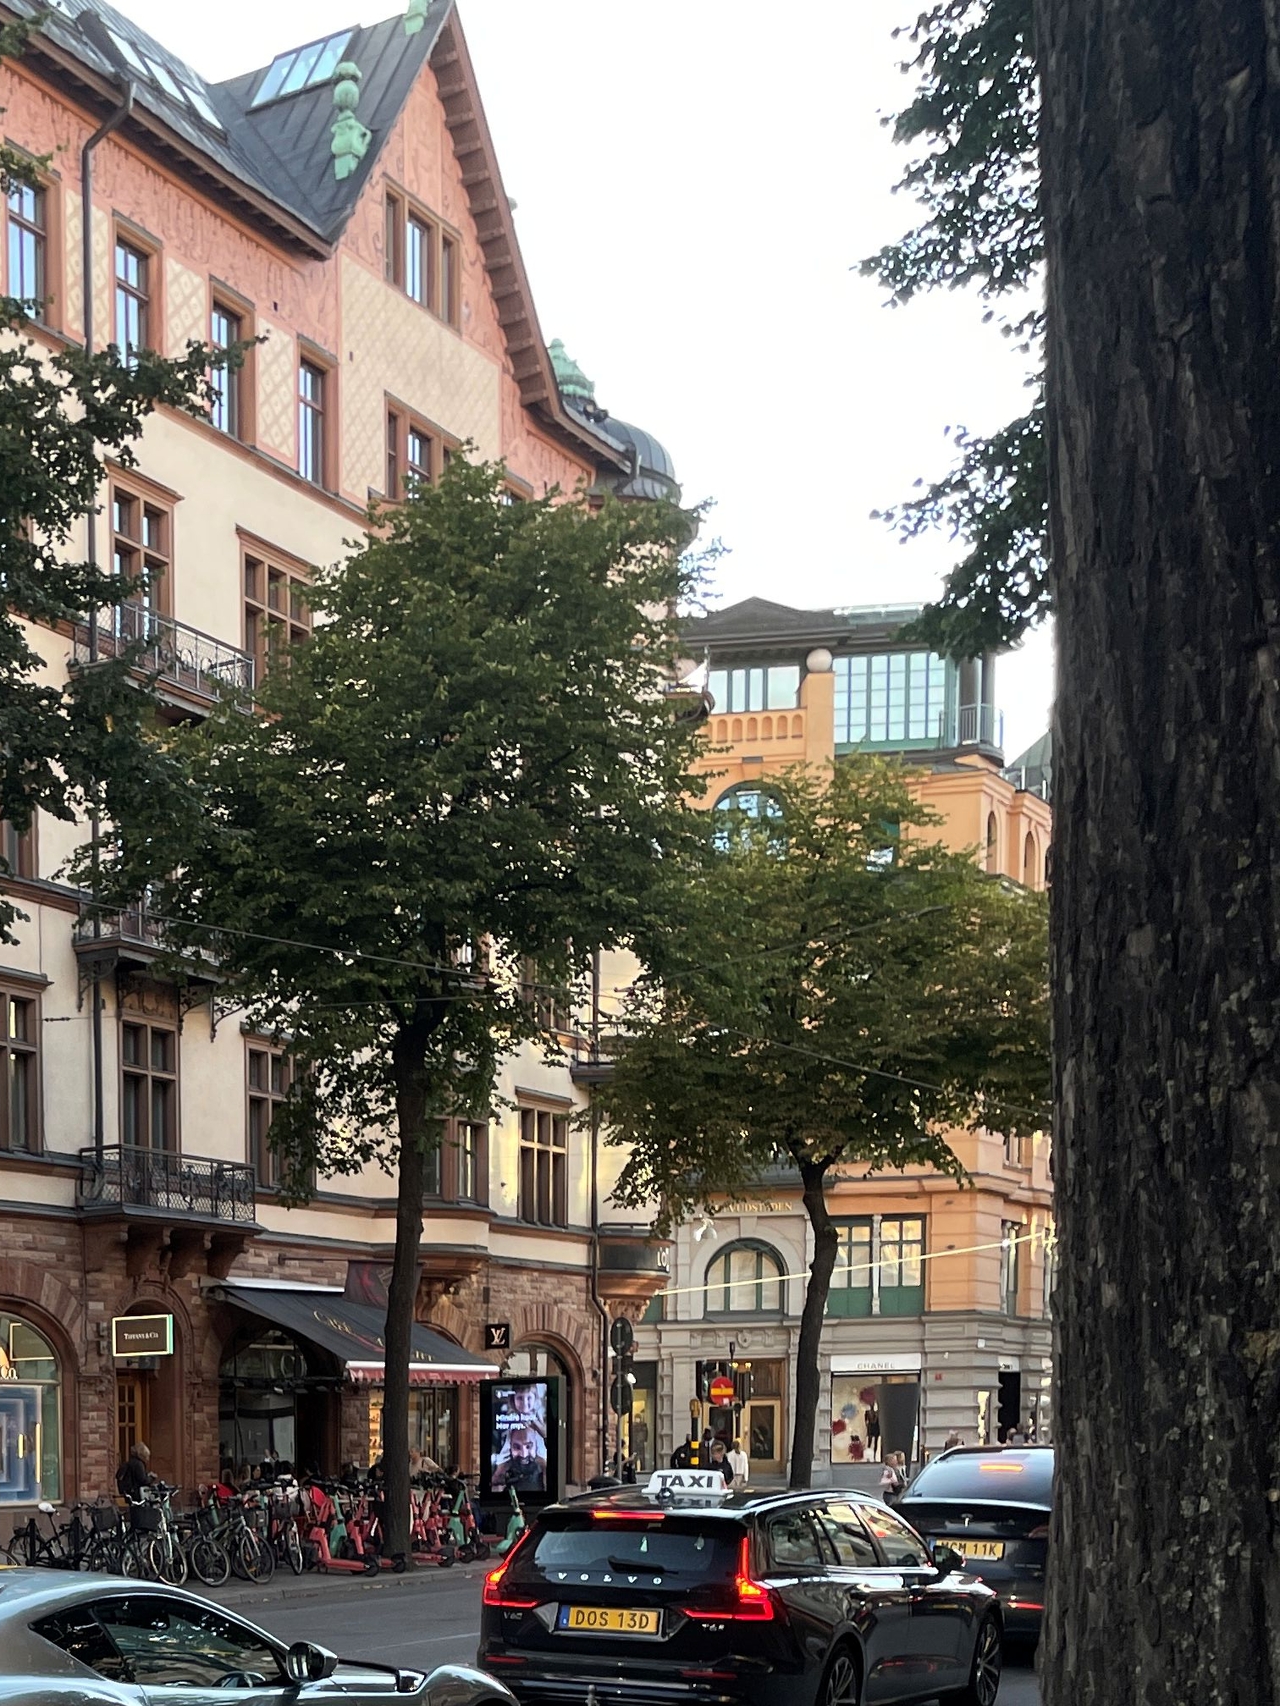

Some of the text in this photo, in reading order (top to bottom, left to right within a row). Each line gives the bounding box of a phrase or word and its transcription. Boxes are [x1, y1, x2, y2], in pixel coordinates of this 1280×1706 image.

[857, 1362, 895, 1370] CHANEL
[657, 1474, 714, 1488] TAXI
[974, 1542, 997, 1556] 11K
[557, 1572, 663, 1585] VOLVO
[575, 1609, 609, 1627] DOS
[618, 1611, 650, 1629] 13D
